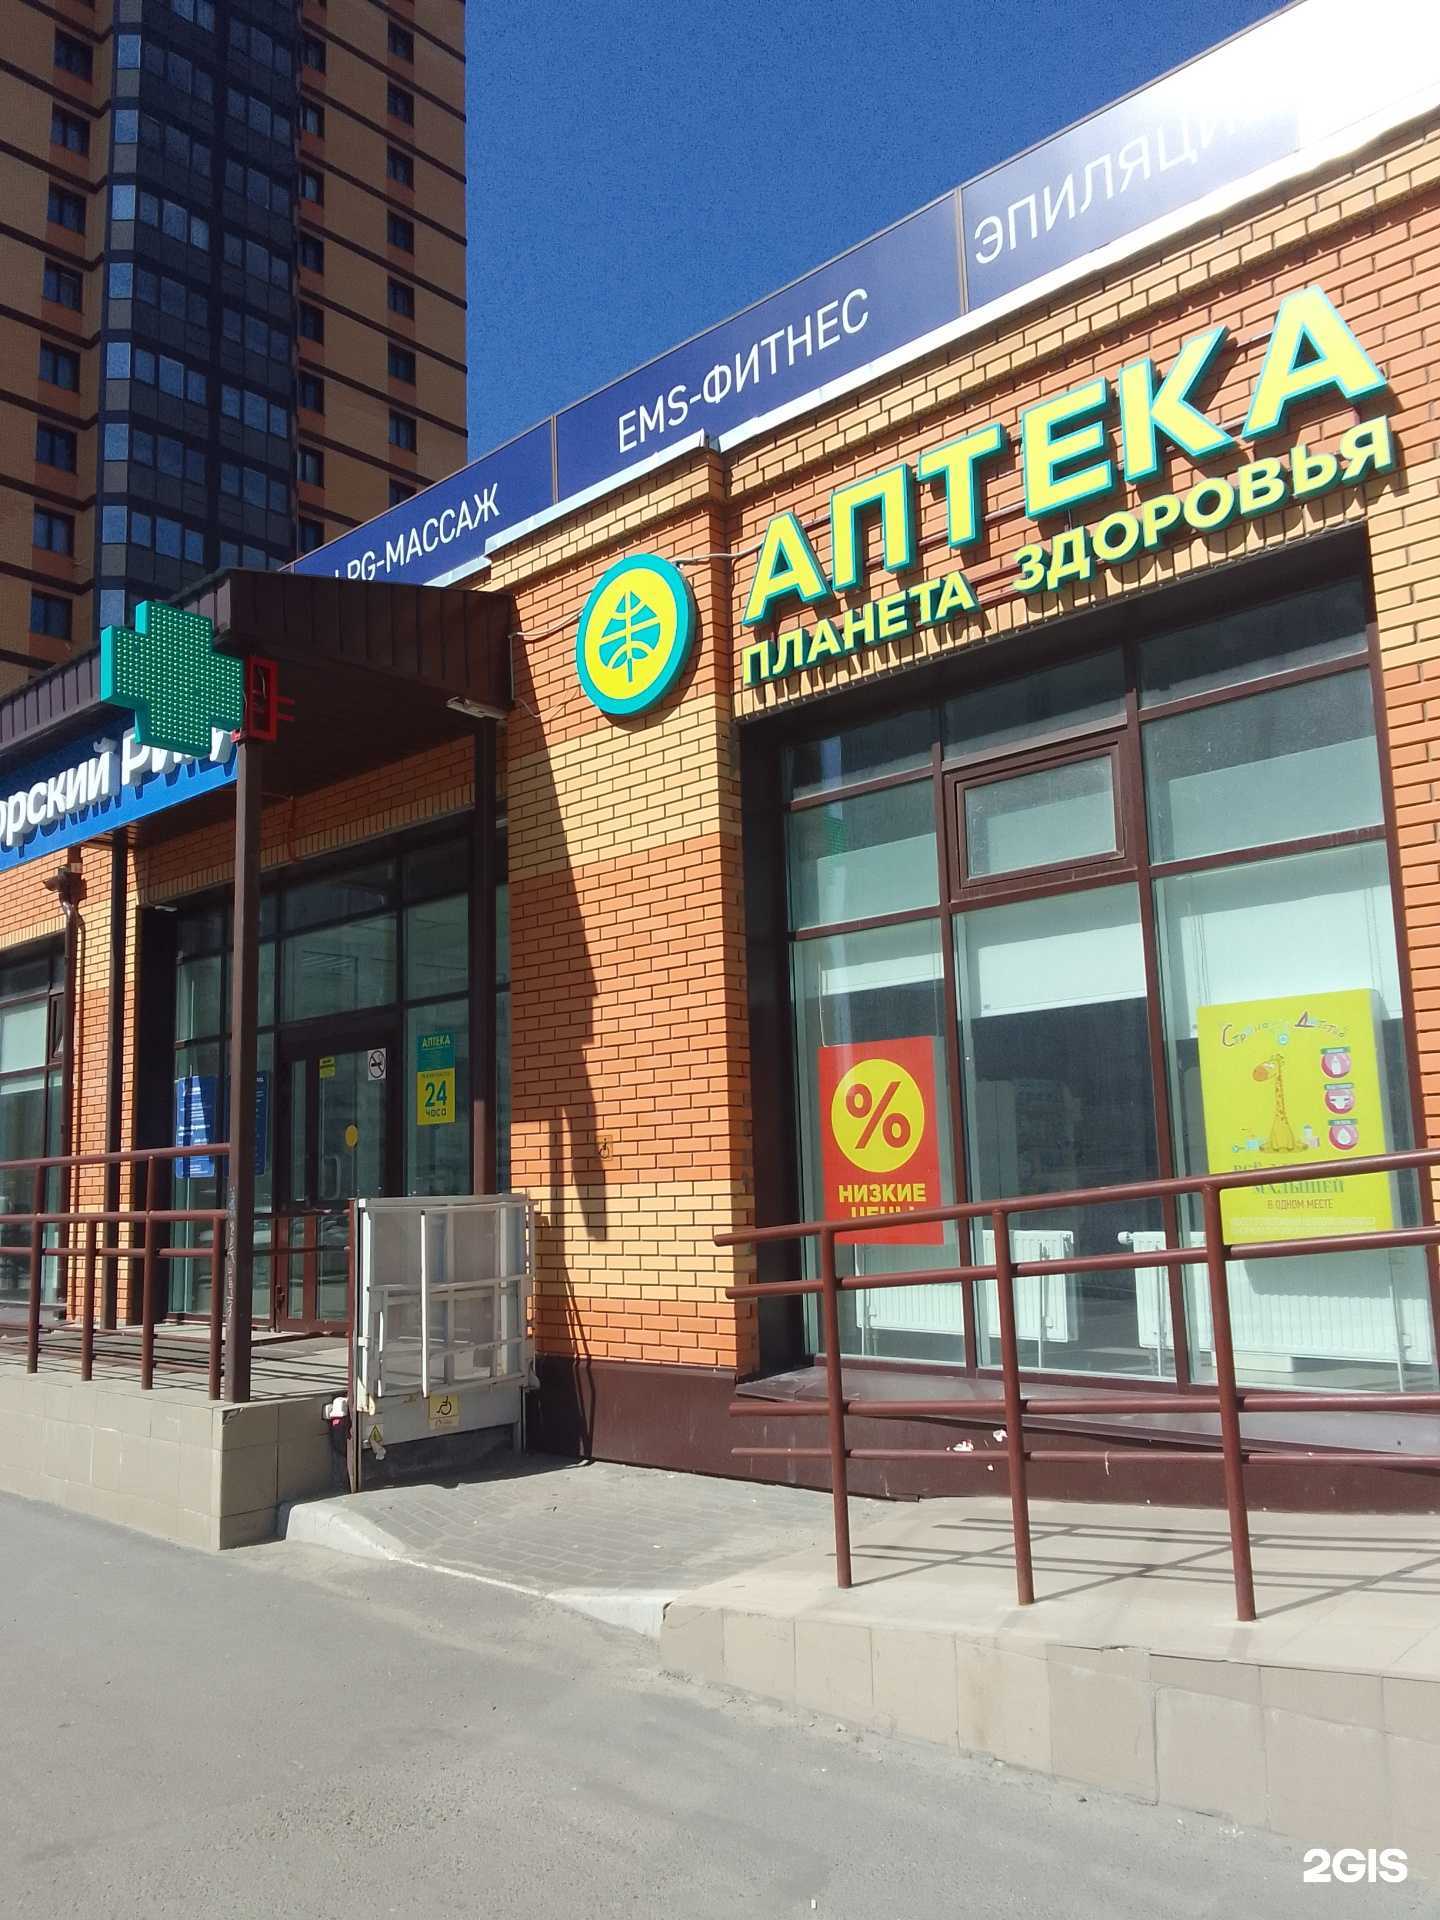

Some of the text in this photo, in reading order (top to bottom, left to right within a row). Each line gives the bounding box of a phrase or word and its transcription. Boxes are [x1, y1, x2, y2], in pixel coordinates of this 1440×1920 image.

[618, 288, 869, 454] EMS-ФИТНЕС
[742, 284, 1388, 627] АПТЕКА
[334, 482, 500, 581] PG-МАССАЖ
[742, 414, 1396, 688] ПЛАНЕТА ЗДОРОВЬЯ
[422, 1034, 451, 1049] АПТЕКА
[424, 1080, 447, 1108] 24
[838, 1183, 927, 1203] НИЗКИЕ
